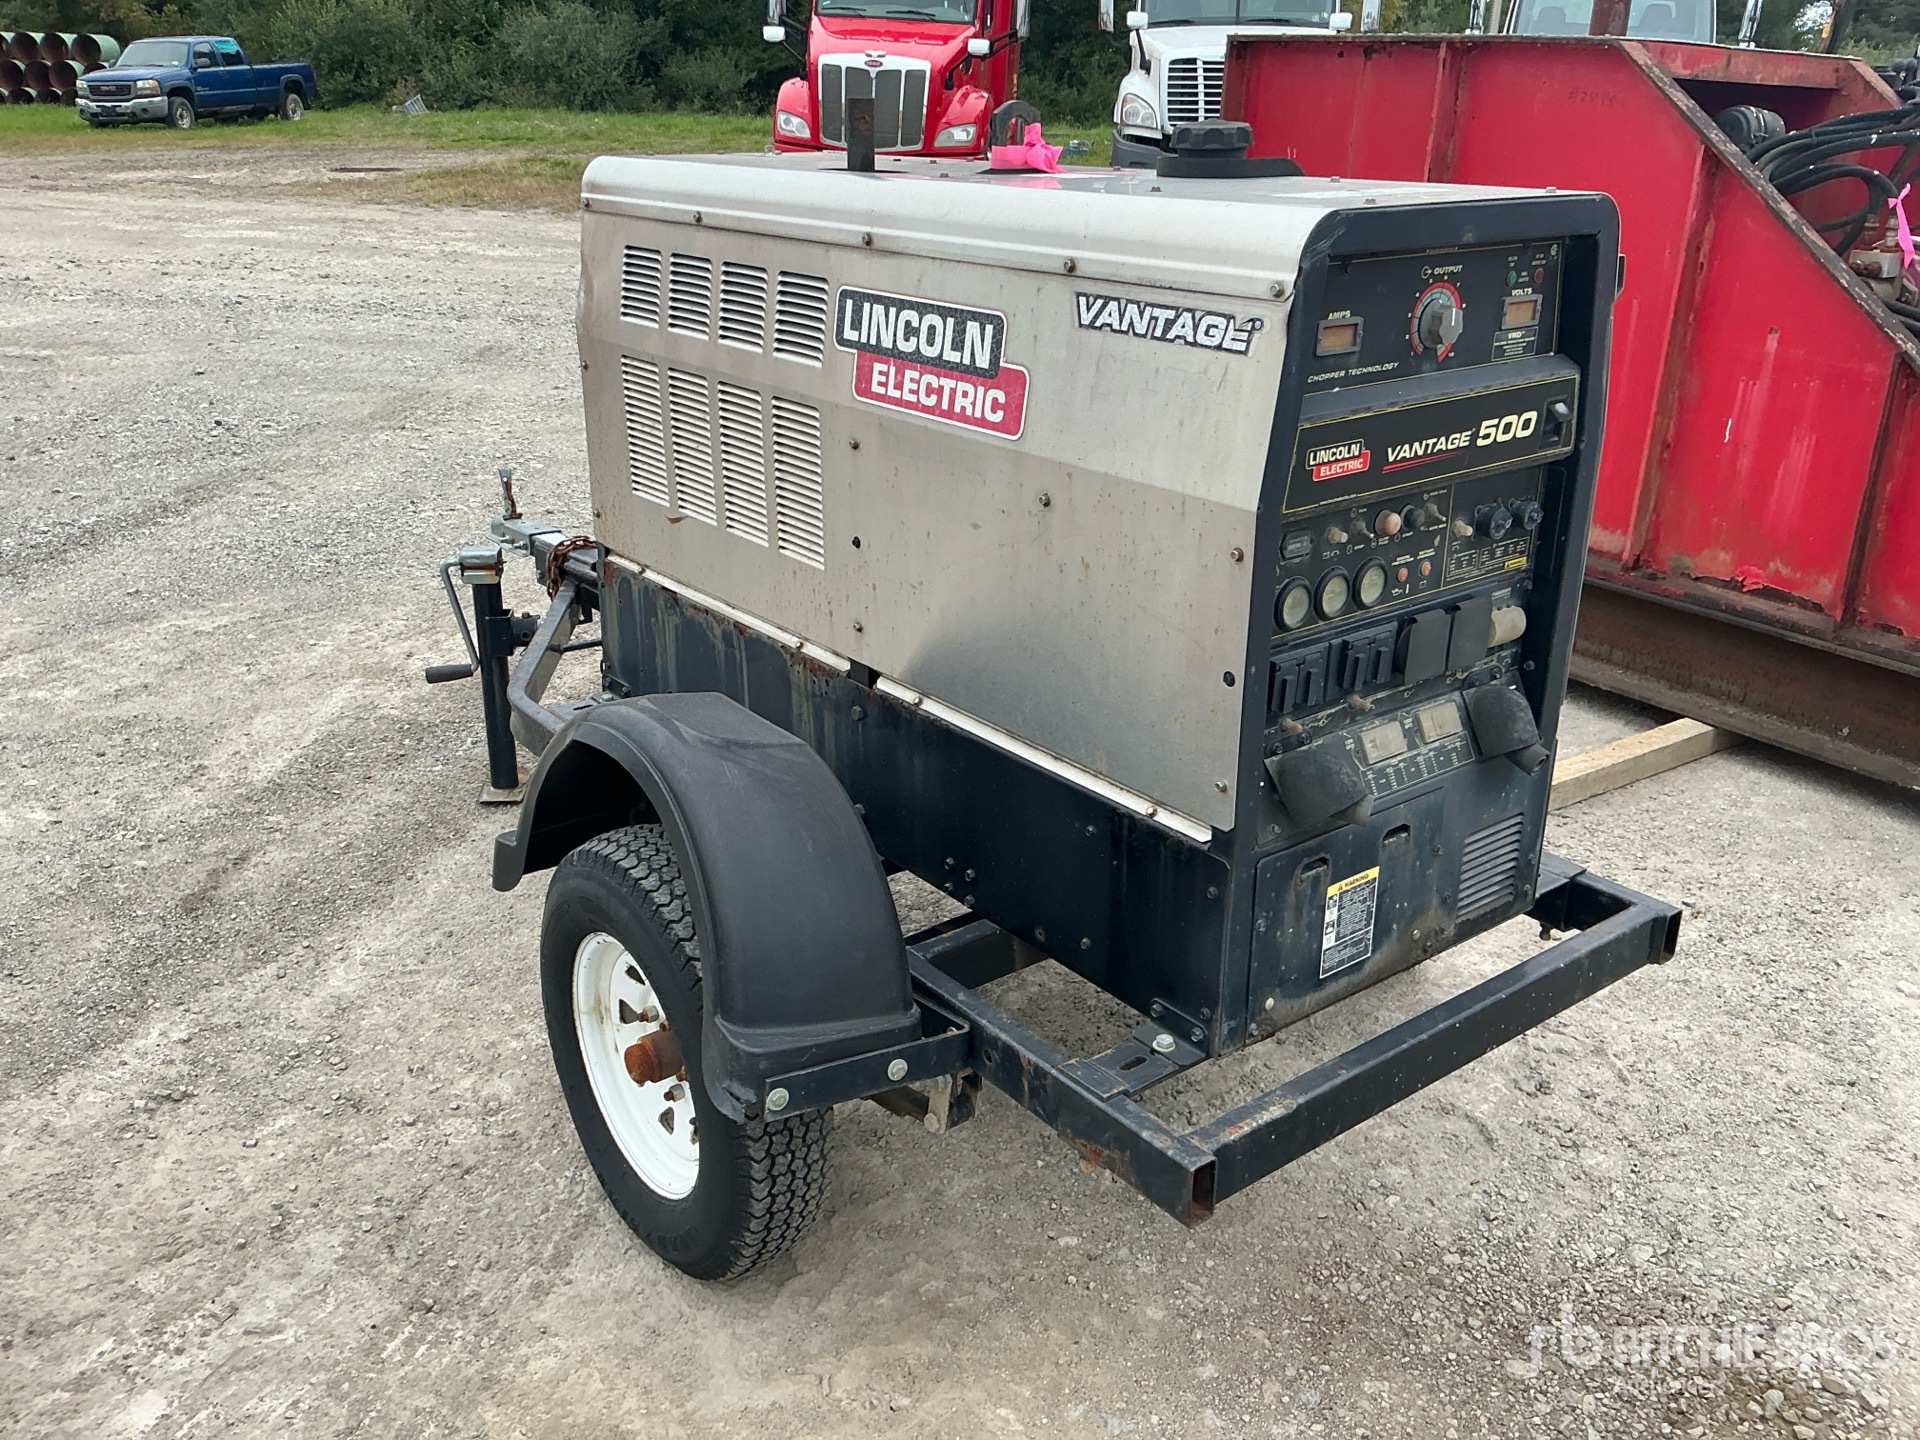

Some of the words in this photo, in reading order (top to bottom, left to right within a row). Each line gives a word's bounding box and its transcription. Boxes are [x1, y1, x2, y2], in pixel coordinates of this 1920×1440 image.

[1433, 265, 1463, 275] OUTPUT
[1511, 287, 1533, 297] VOLTS
[1079, 296, 1251, 352] VANTAGE
[1327, 310, 1351, 320] AMPS
[843, 299, 994, 370] LINCOLN
[1307, 370, 1346, 383] CHOPPER
[1348, 361, 1400, 376] TECHNOLOGY
[871, 361, 1006, 423] ELECTRIC
[1387, 430, 1472, 463] VANTAGE
[1476, 410, 1538, 447] 500
[1309, 443, 1361, 466] LINCOLN
[1319, 458, 1364, 477] ELECTRIC
[1344, 873, 1369, 887] WARNING
